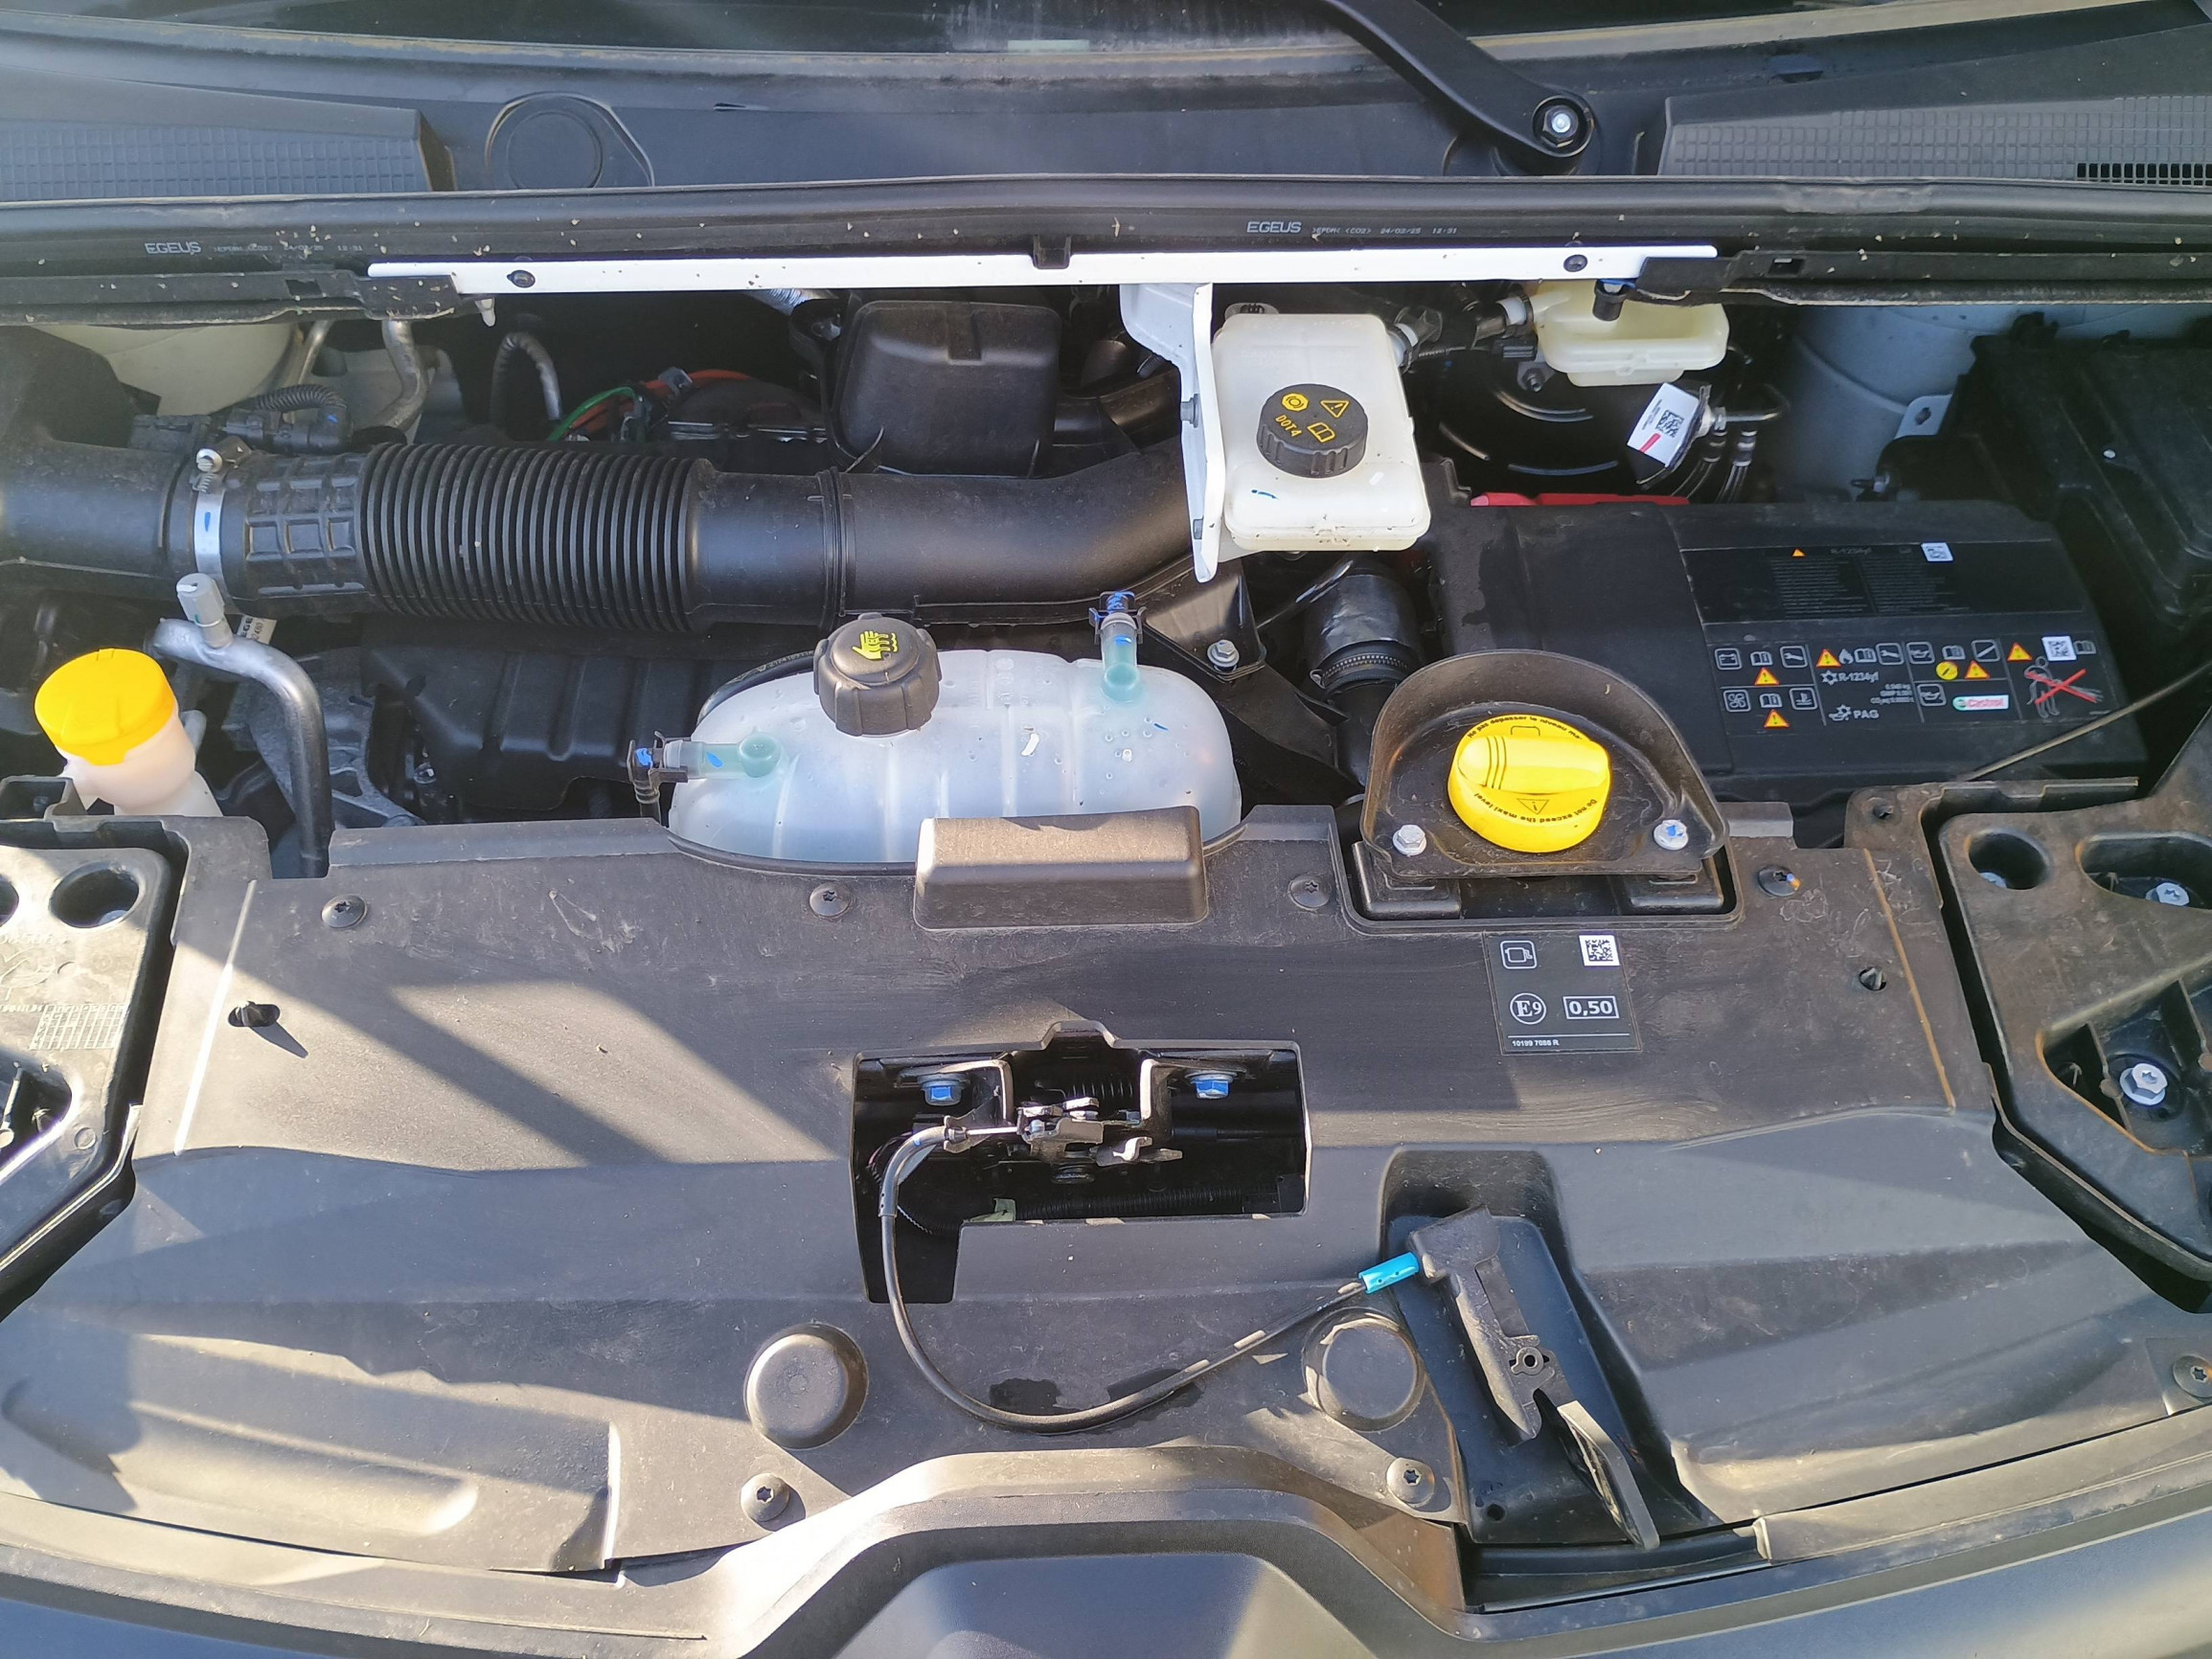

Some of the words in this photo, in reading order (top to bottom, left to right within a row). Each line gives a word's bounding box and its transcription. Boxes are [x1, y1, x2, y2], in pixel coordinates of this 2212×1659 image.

[1246, 220, 1303, 234] EGEUS
[144, 241, 202, 255] EGEUS
[1853, 709, 1880, 719] PAG
[1473, 792, 1494, 809] level
[1585, 798, 1598, 808] Do
[1493, 807, 1517, 819] maxi
[1573, 805, 1587, 816] not
[1539, 813, 1573, 824] exceed
[1568, 1000, 1613, 1017] 0,50
